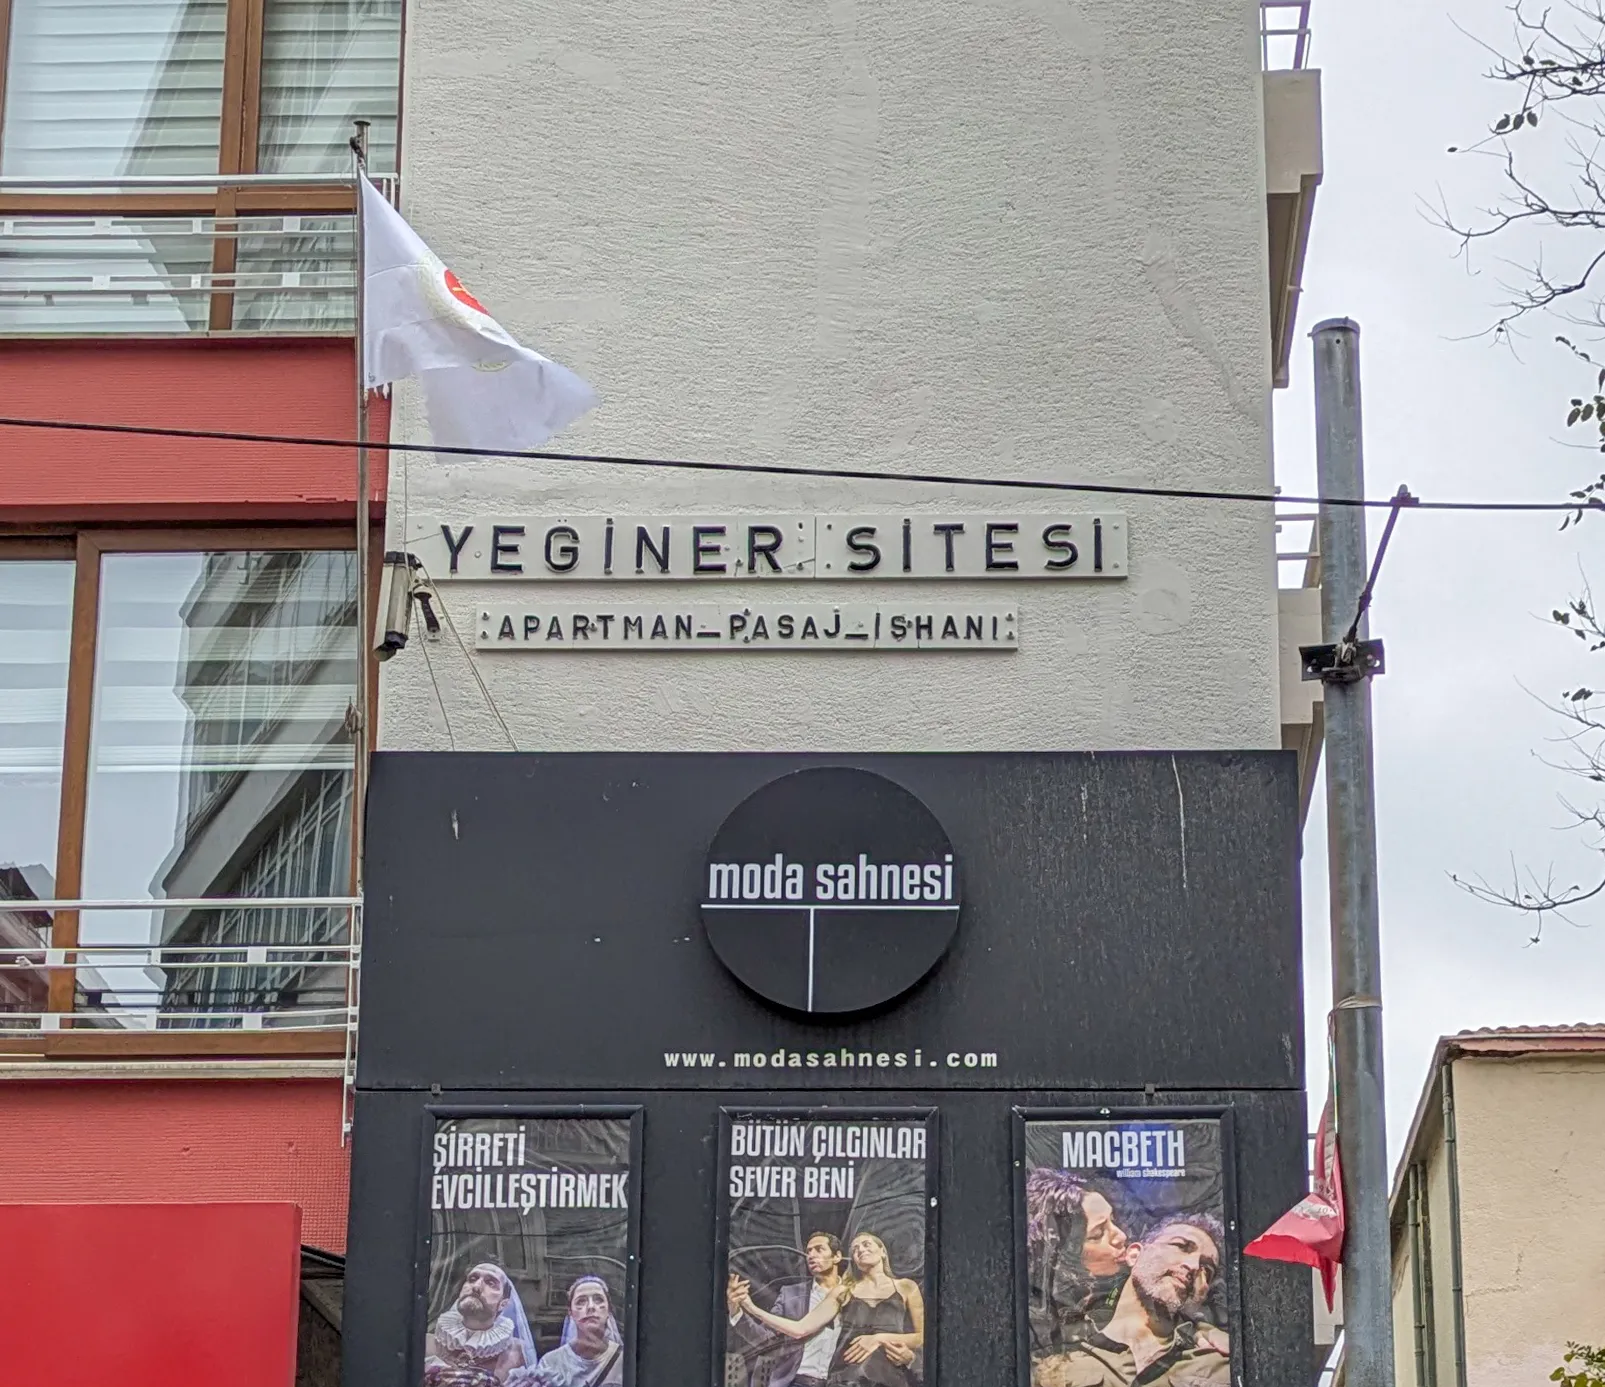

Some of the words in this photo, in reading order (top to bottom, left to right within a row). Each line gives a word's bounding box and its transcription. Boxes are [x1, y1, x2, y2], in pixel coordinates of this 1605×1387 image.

[708, 853, 804, 900] moda
[815, 853, 953, 901] sahnesi
[664, 1048, 998, 1068] www.modasahnesi.com
[432, 1125, 526, 1174] ŞİRRETİ
[731, 1120, 805, 1158] BÜTÜN
[812, 1126, 927, 1164] ÇILGINLAR
[1062, 1130, 1186, 1168] MACBETH
[431, 1167, 629, 1215] EVCİLLEŞTİRMEK
[729, 1165, 797, 1198] SEVER
[803, 1161, 854, 1199] BENİ
